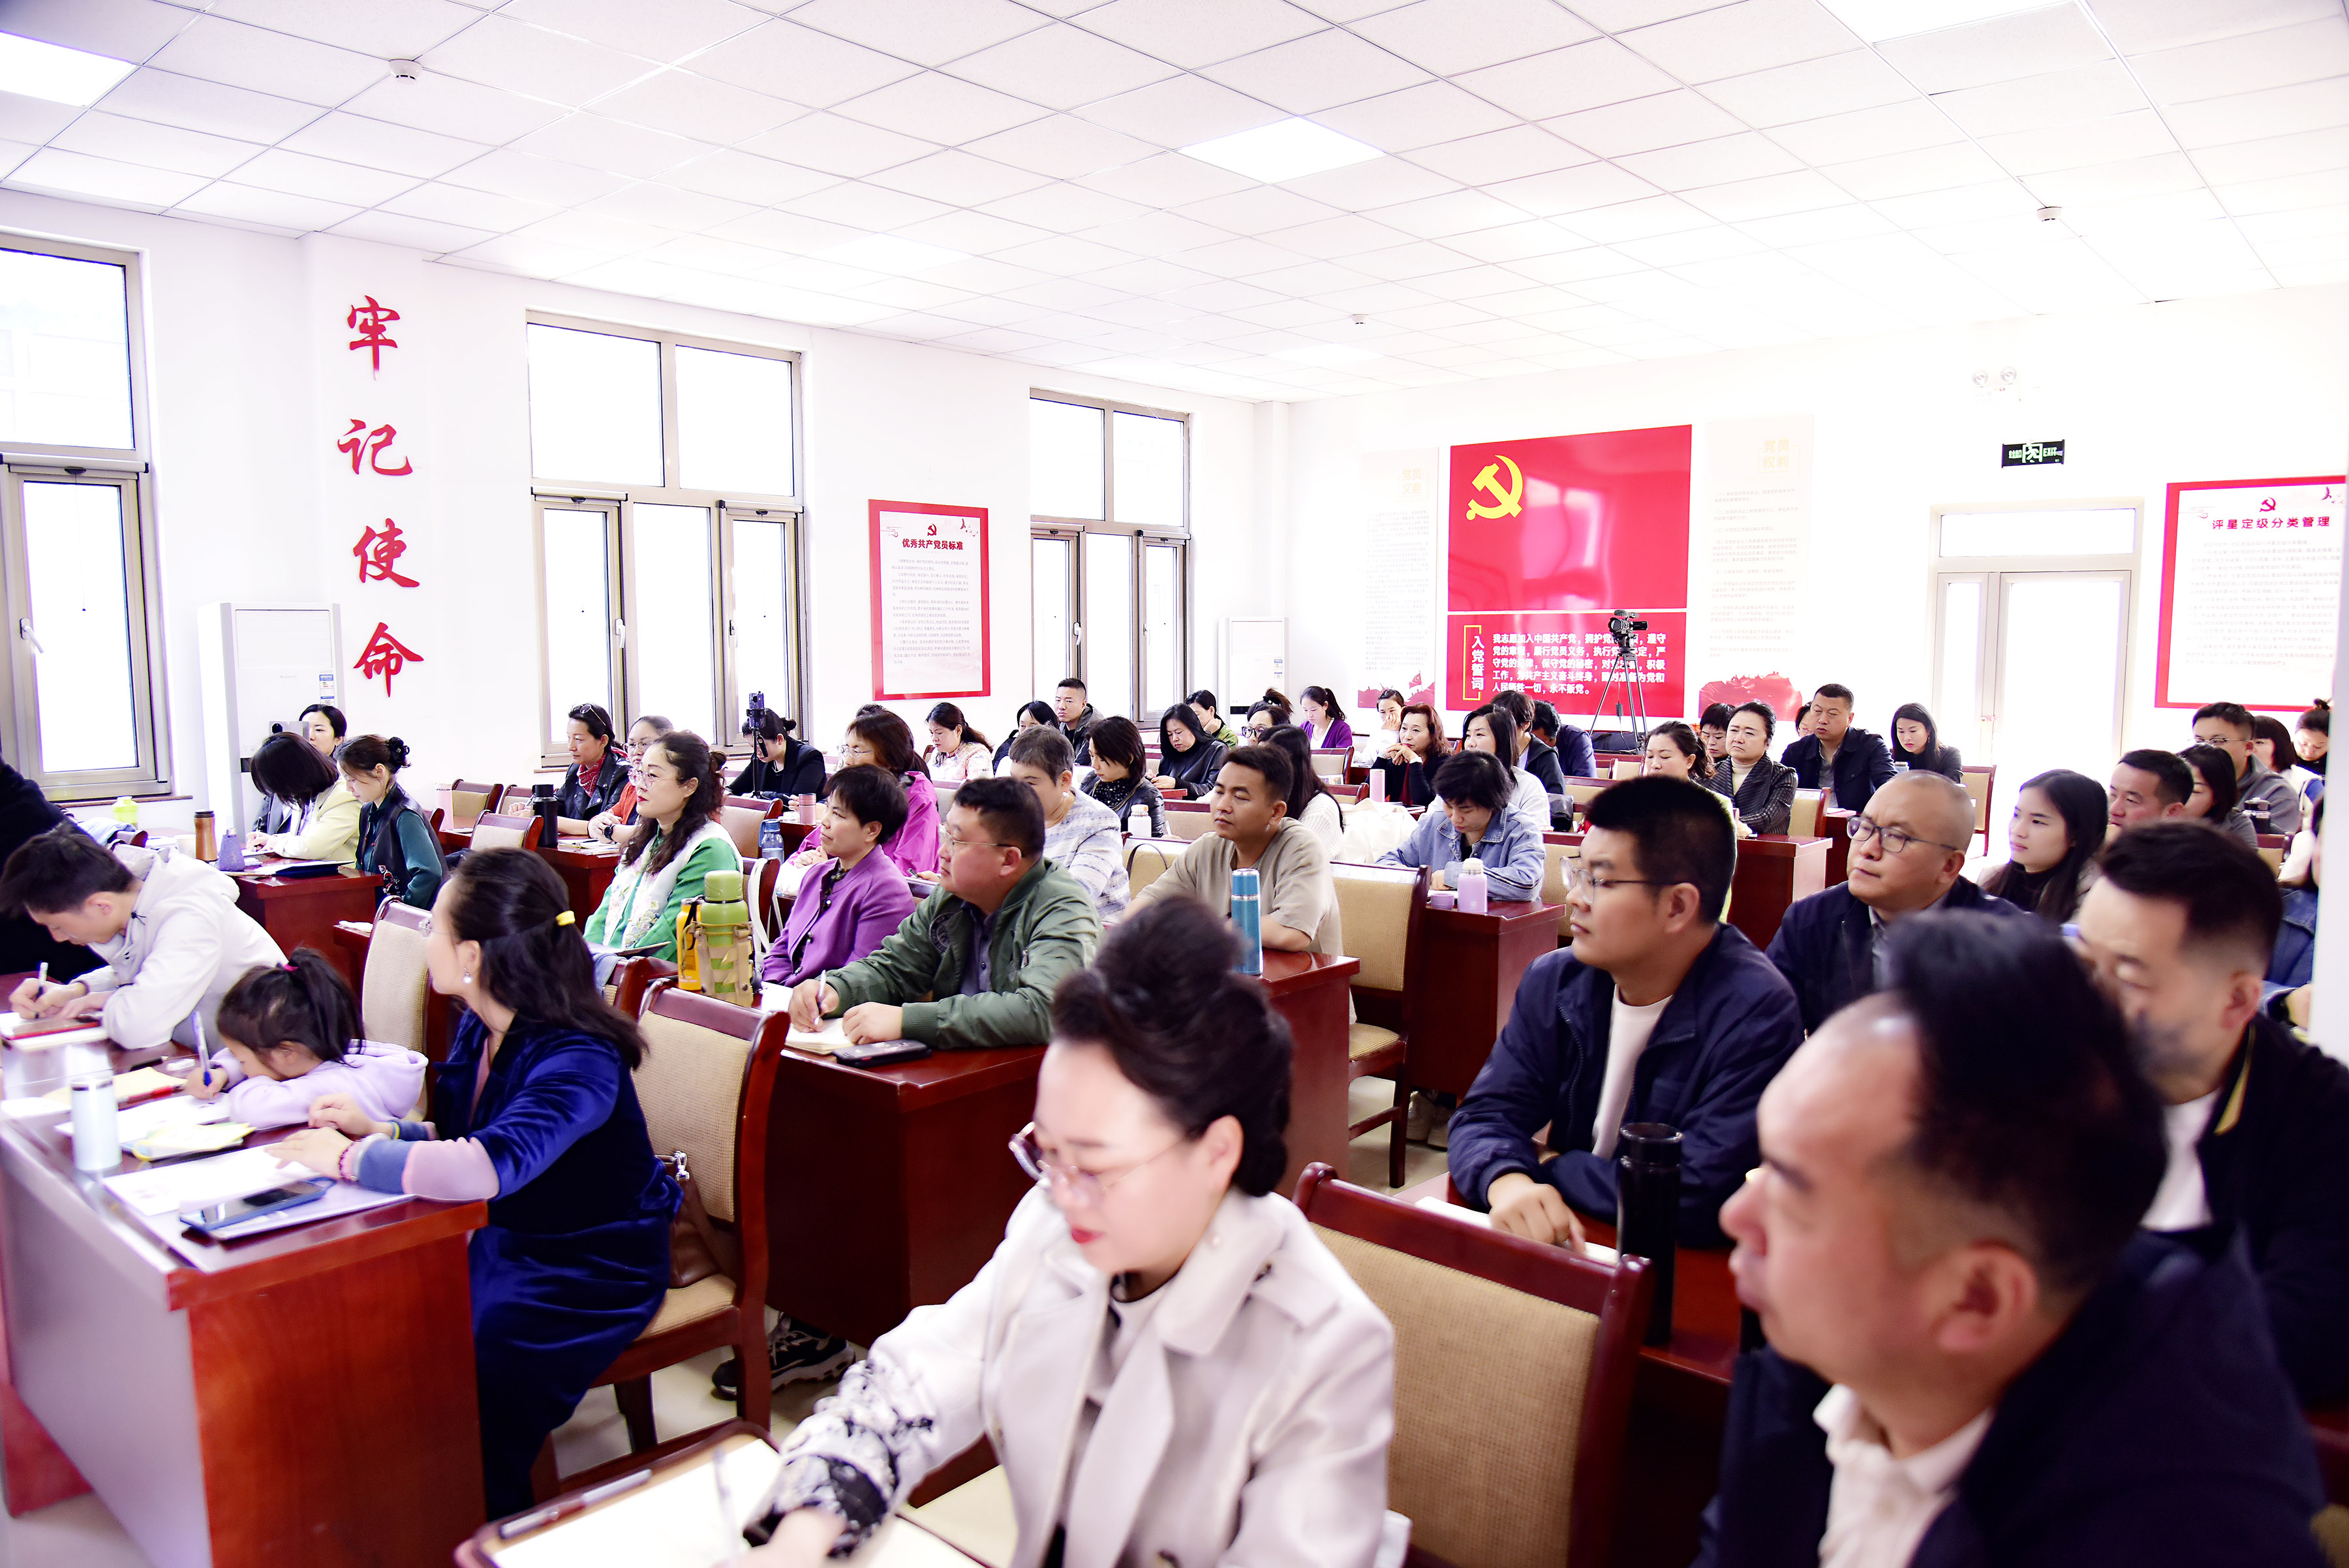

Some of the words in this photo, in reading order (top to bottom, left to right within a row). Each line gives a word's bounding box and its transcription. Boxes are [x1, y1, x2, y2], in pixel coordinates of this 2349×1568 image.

[1764, 438, 1790, 453] 党员
[2043, 446, 2057, 457] EXIT
[337, 295, 424, 698] 牢记使命
[2212, 516, 2330, 530] 评星定级分类管理
[902, 538, 964, 551] 优秀共产党员标准
[1471, 635, 1485, 691] 入党誓词
